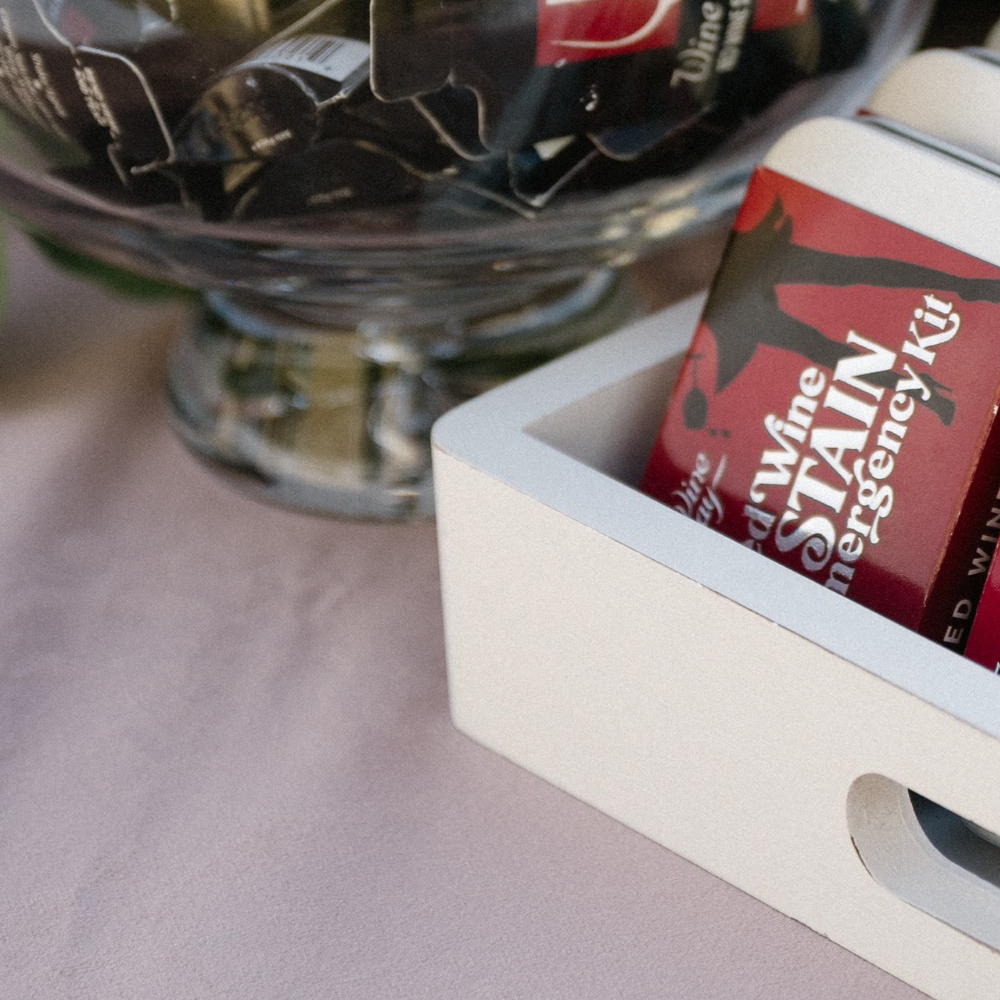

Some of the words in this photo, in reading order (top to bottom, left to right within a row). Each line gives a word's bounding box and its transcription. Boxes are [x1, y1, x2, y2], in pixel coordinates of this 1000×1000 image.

[669, 2, 725, 87] Wine
[749, 367, 826, 503] Wine
[775, 330, 898, 572] STAIN
[825, 363, 932, 596] mergency
[902, 293, 961, 366] Kit
[943, 598, 972, 645] ED
